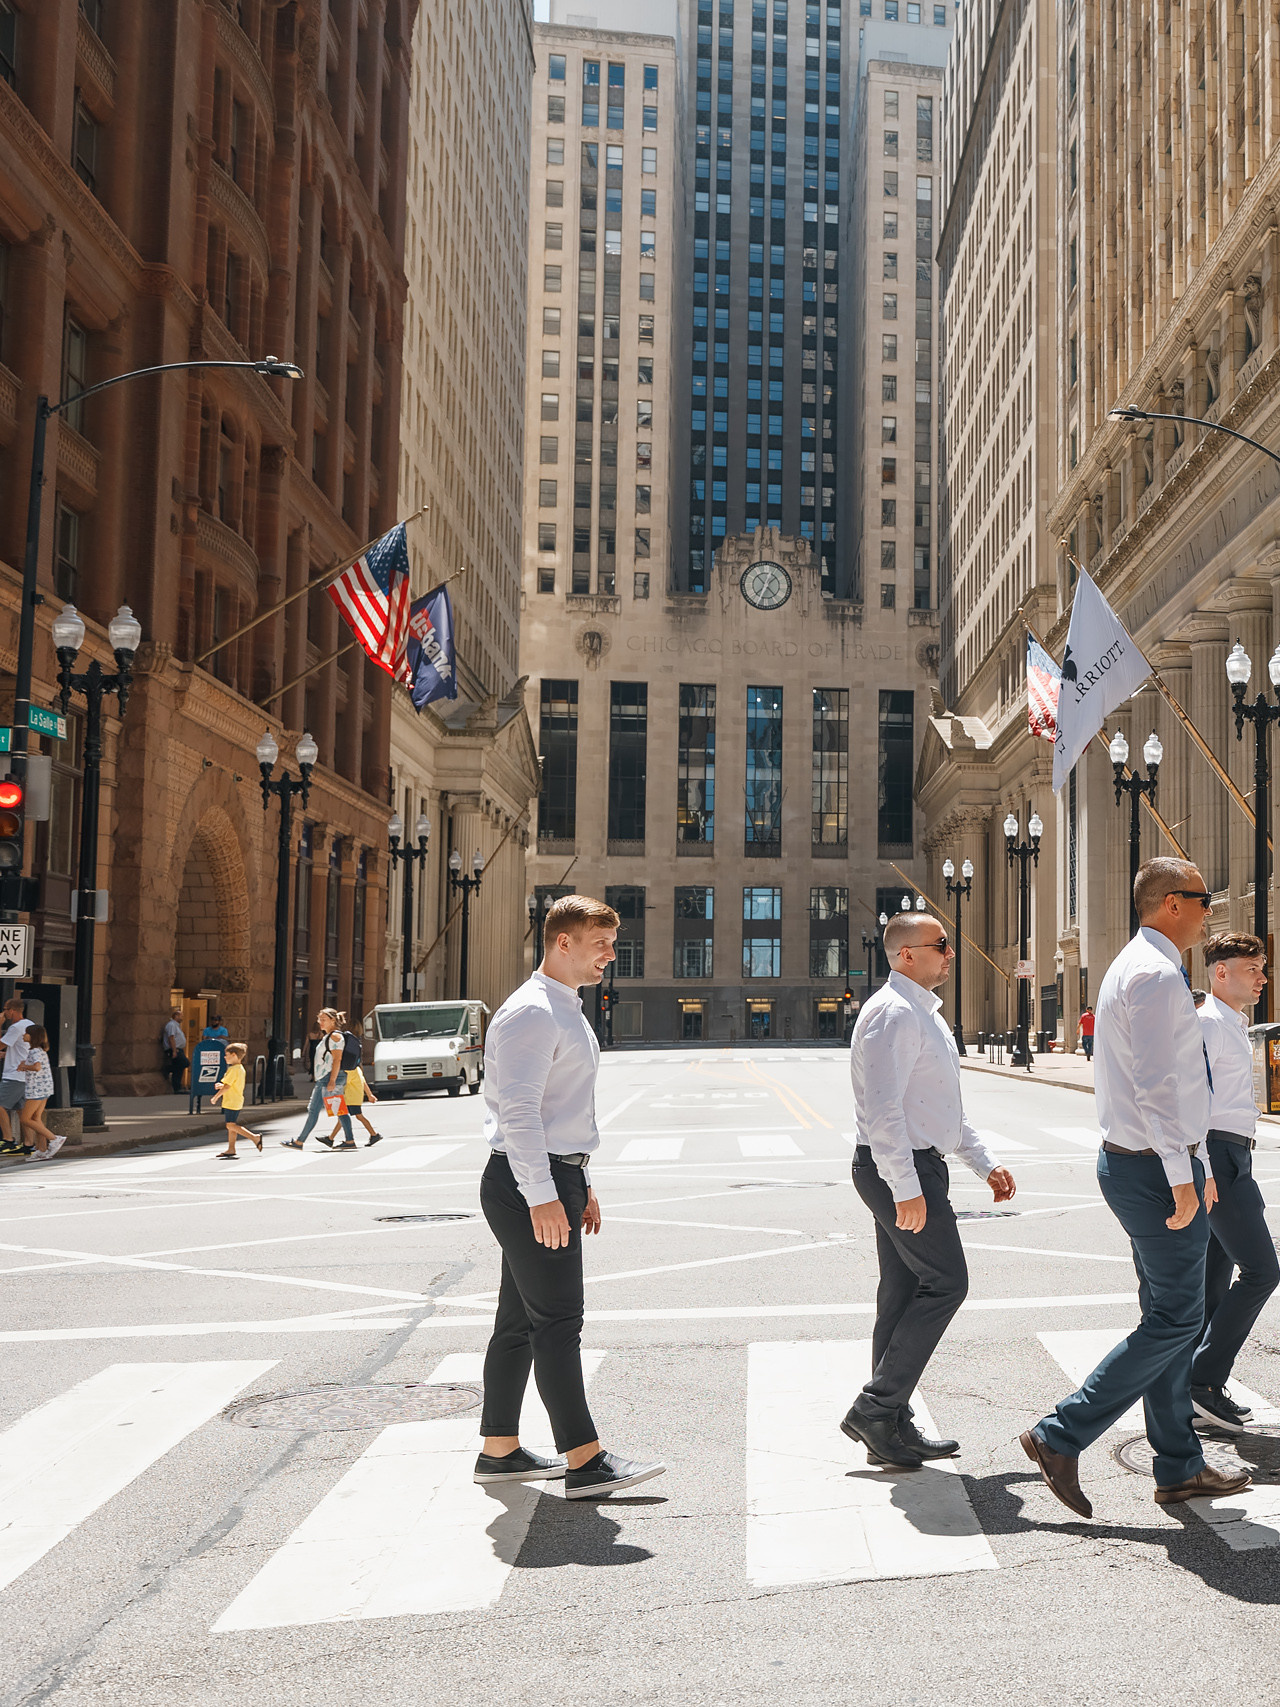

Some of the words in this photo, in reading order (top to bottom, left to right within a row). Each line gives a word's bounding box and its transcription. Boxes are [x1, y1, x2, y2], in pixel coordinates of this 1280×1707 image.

[626, 636, 723, 655] CHICAGO
[731, 639, 798, 658] BOARD
[808, 642, 834, 658] OF
[845, 643, 904, 661] TRADE
[1075, 639, 1125, 704] RRIOTT
[30, 709, 38, 725] La
[0, 929, 21, 942] NE
[0, 943, 21, 956] AY
